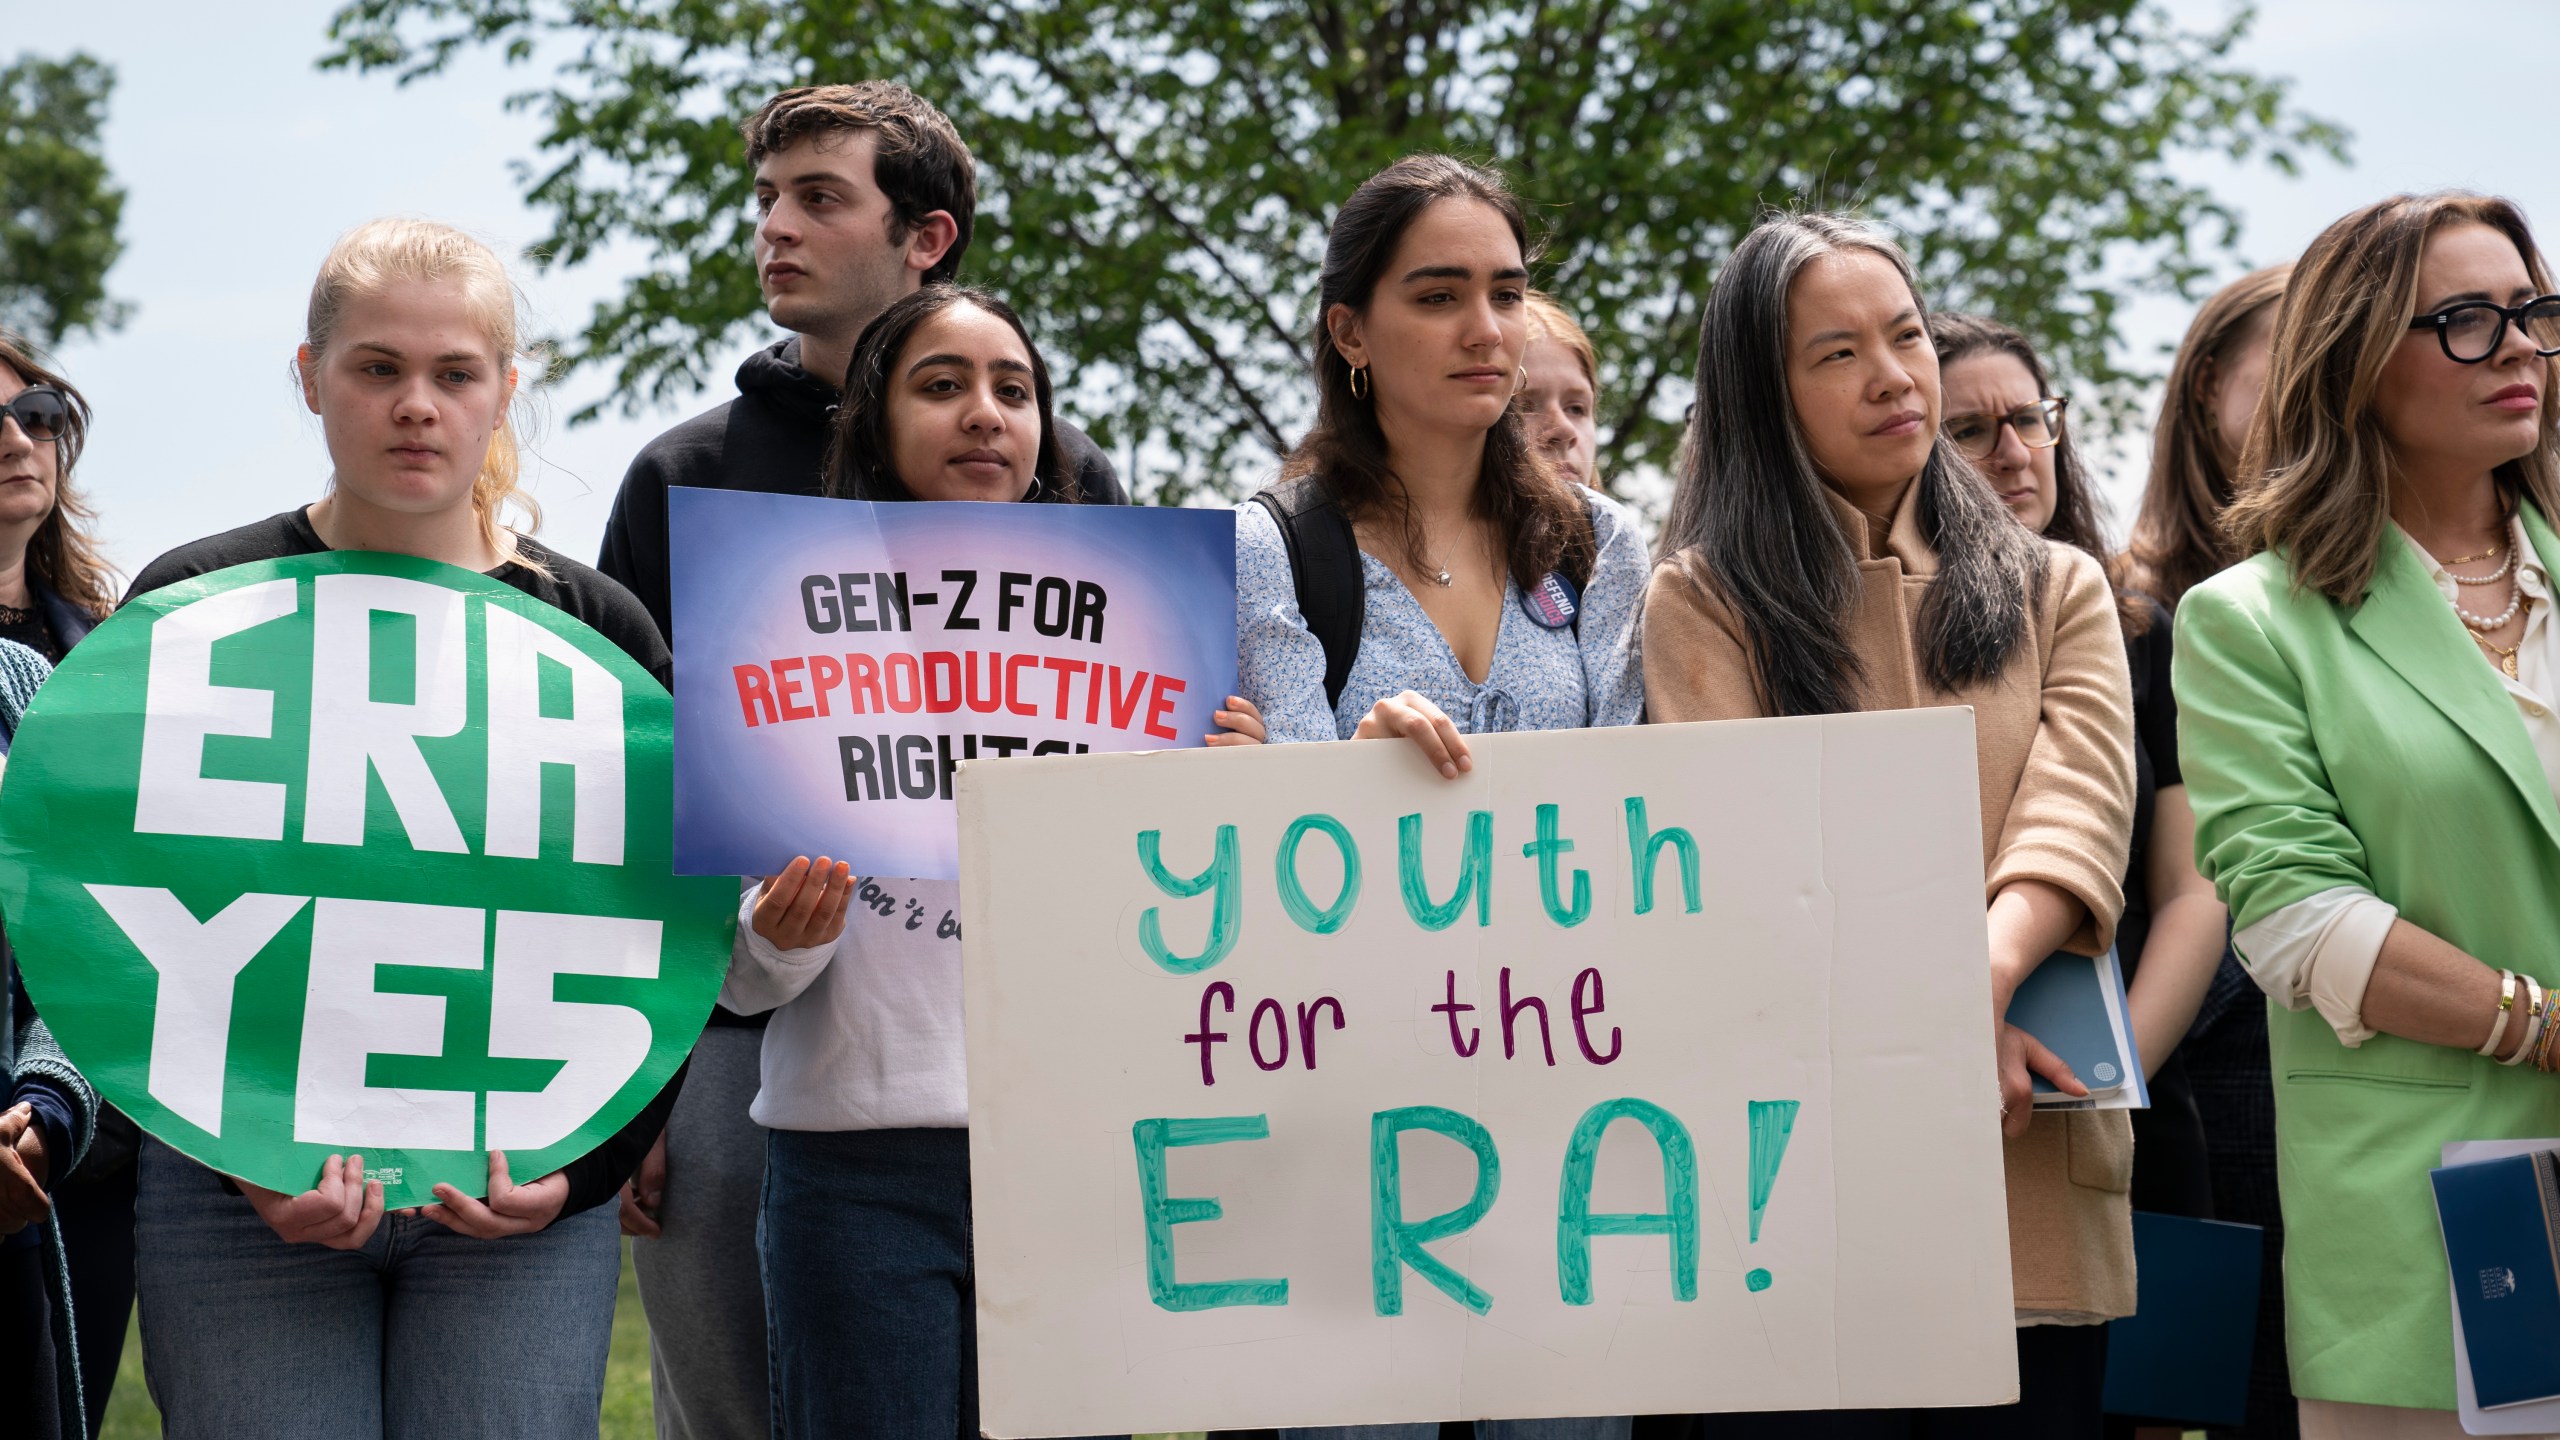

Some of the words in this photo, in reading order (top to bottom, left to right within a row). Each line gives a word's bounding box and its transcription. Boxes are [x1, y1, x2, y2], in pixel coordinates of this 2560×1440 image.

[800, 569, 981, 635] GEN-Z
[998, 570, 1108, 644] FOR
[133, 573, 626, 866] ERA
[732, 650, 1187, 741] REPRODUCTIVE
[837, 734, 1090, 802] RIGH
[858, 876, 925, 931] on't
[936, 909, 962, 941] b
[1137, 796, 1703, 976] youth
[82, 883, 664, 1151] YES
[1184, 981, 1345, 1086] for
[1431, 966, 1622, 1067] the
[1133, 1098, 1800, 1317] ERA!
[2480, 1270, 2490, 1299] SENATE
[2489, 1268, 2498, 1298] STATES
[2495, 1266, 2505, 1298] UNITED
